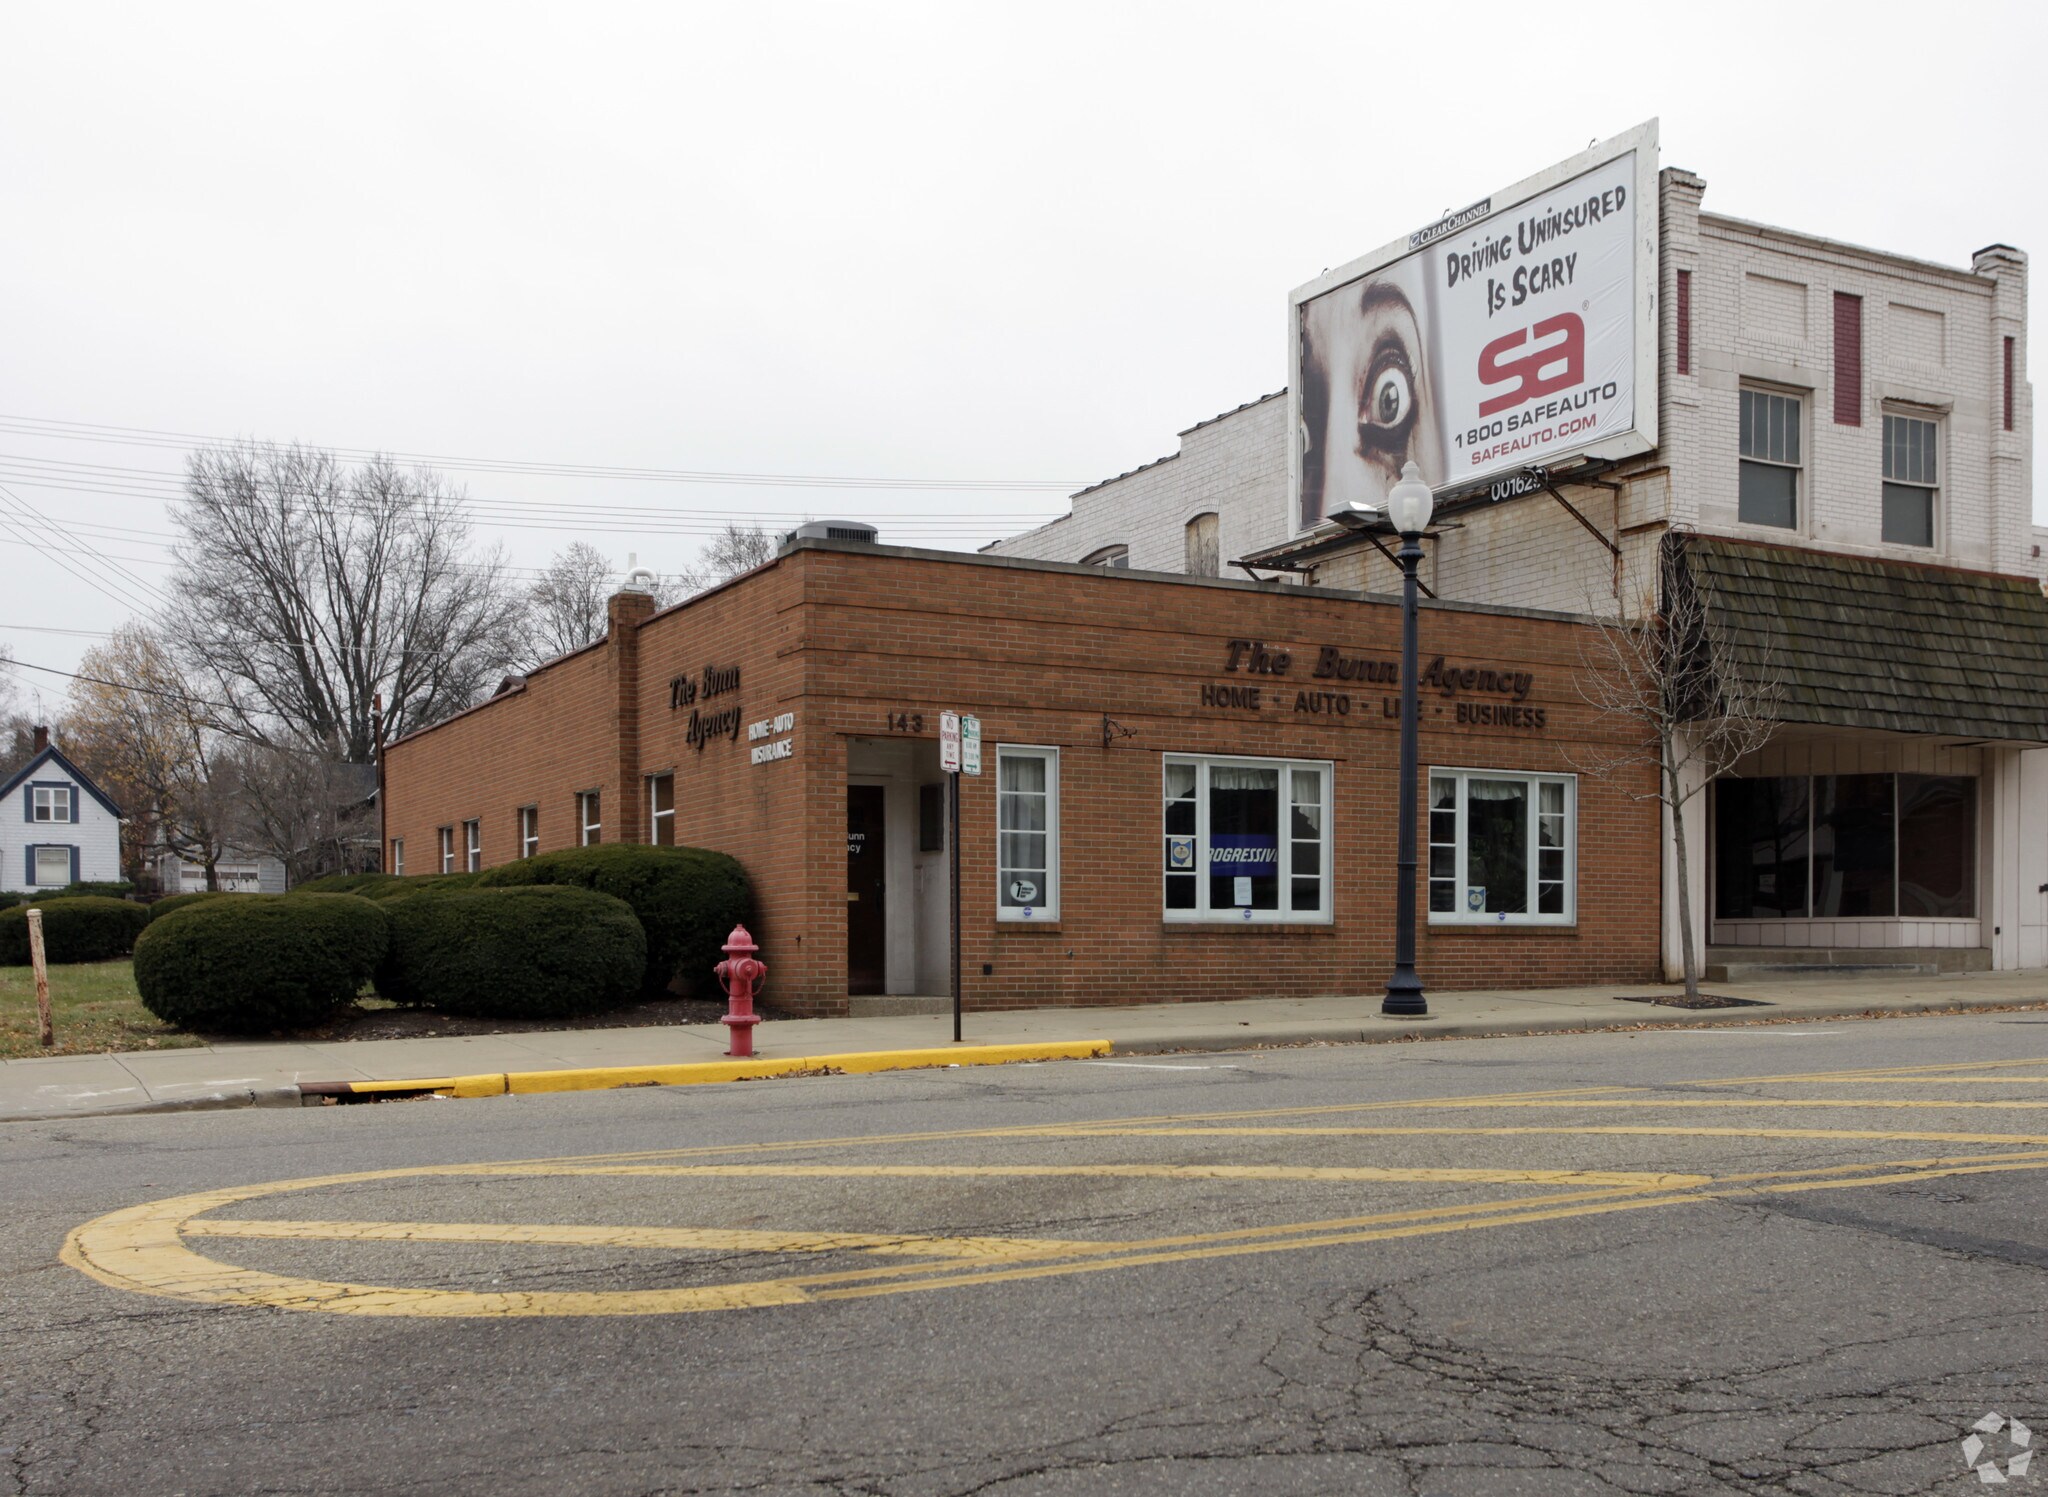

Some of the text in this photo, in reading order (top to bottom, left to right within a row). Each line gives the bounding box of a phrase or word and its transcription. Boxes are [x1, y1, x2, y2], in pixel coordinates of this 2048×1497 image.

[1512, 252, 1578, 307] SCARY
[1507, 381, 1617, 432] SAFEAUTO
[1471, 413, 1597, 466] SAFEAUTO.COM
[669, 665, 740, 710] The Bunn
[1225, 639, 1533, 701] The Bunn Agency
[686, 706, 742, 752] Agency
[888, 711, 923, 733] 143
[1201, 684, 1261, 711] HOME
[1293, 690, 1351, 716] AUTO
[1383, 697, 1424, 721] LIE
[1456, 702, 1547, 729] BUSINESS
[751, 737, 793, 765] INSURANCE
[941, 730, 959, 743] PARKING
